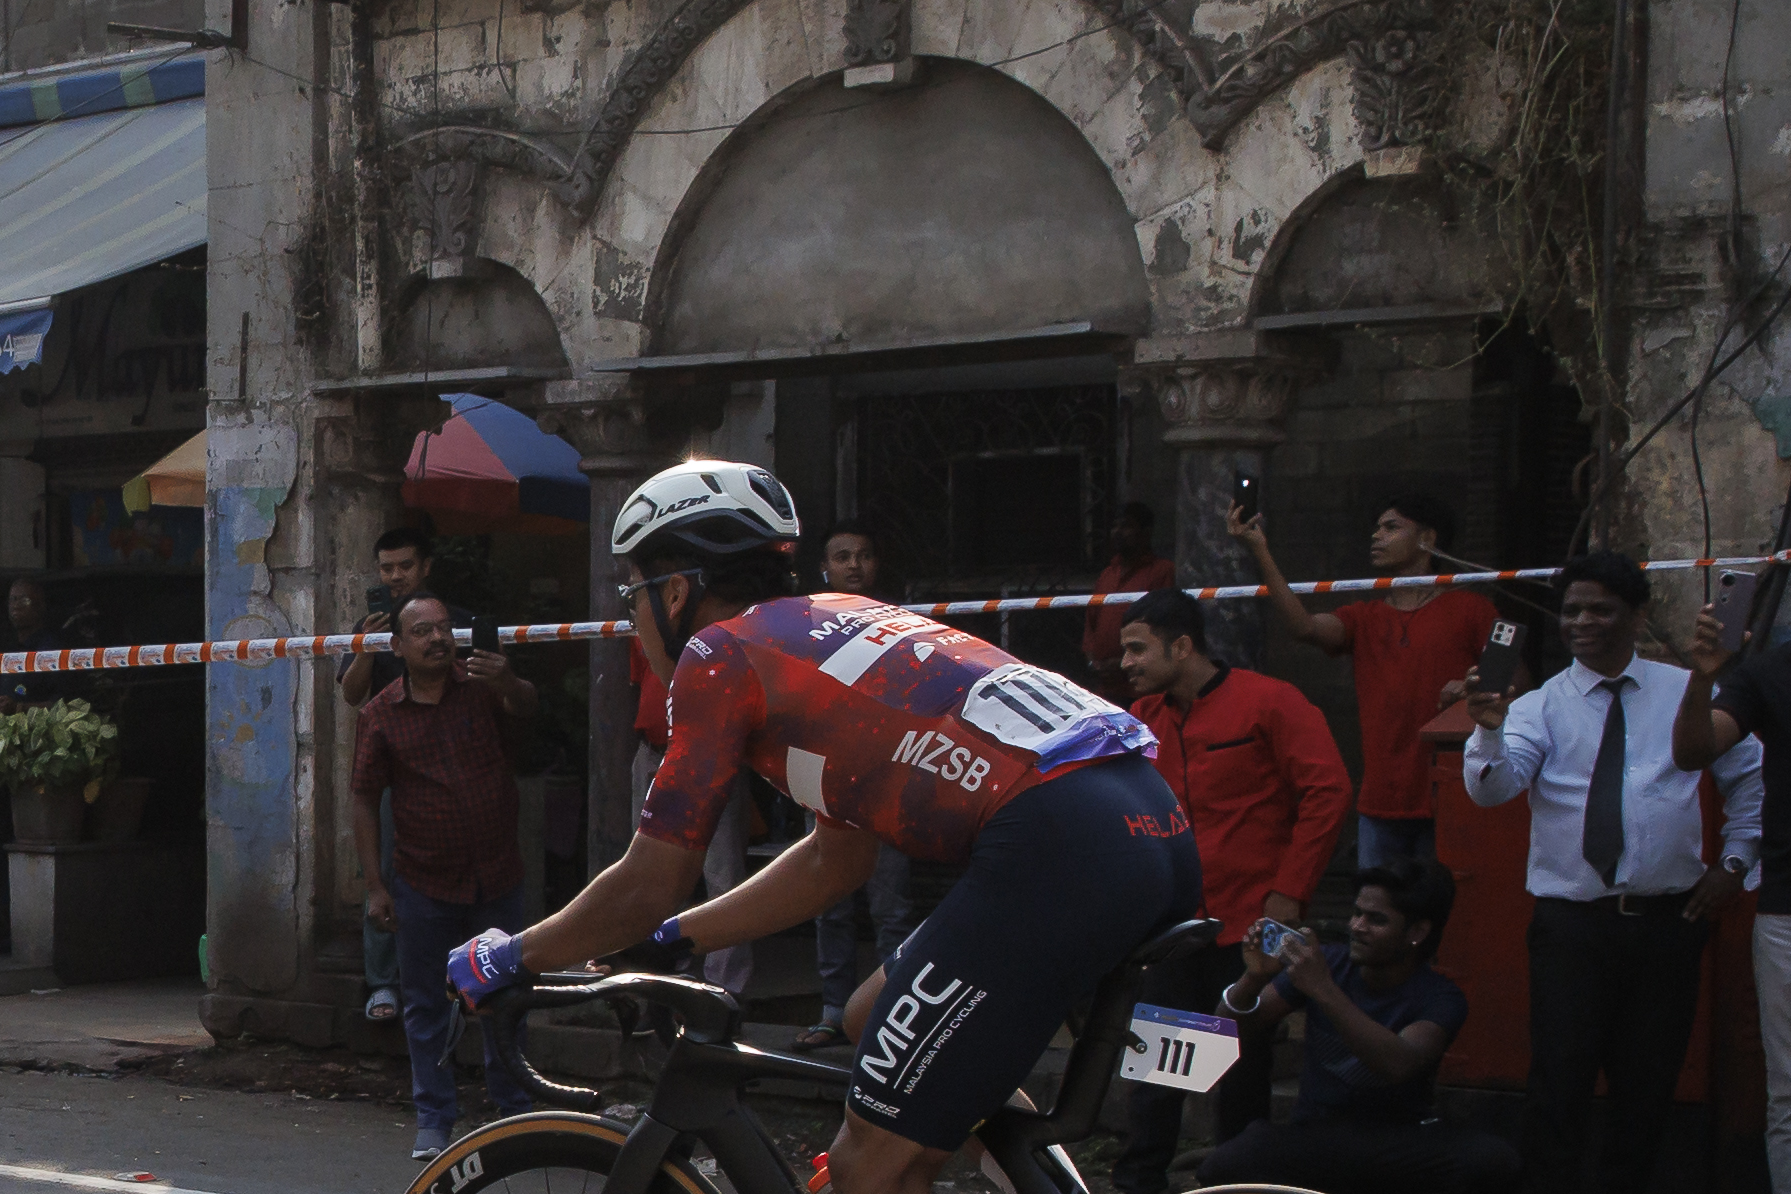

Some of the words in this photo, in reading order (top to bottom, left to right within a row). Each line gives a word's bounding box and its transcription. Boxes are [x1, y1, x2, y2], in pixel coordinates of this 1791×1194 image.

[656, 494, 711, 519] LAZER
[891, 730, 991, 792] MZSB
[476, 936, 500, 980] MPC
[860, 961, 963, 1085] MPC
[903, 1049, 938, 1095] MALAYSIA
[932, 1027, 954, 1050] PRO
[950, 988, 988, 1030] CYCLING
[1156, 1036, 1197, 1078] 111
[863, 1093, 901, 1114] PRO
[449, 1151, 485, 1194] DT
